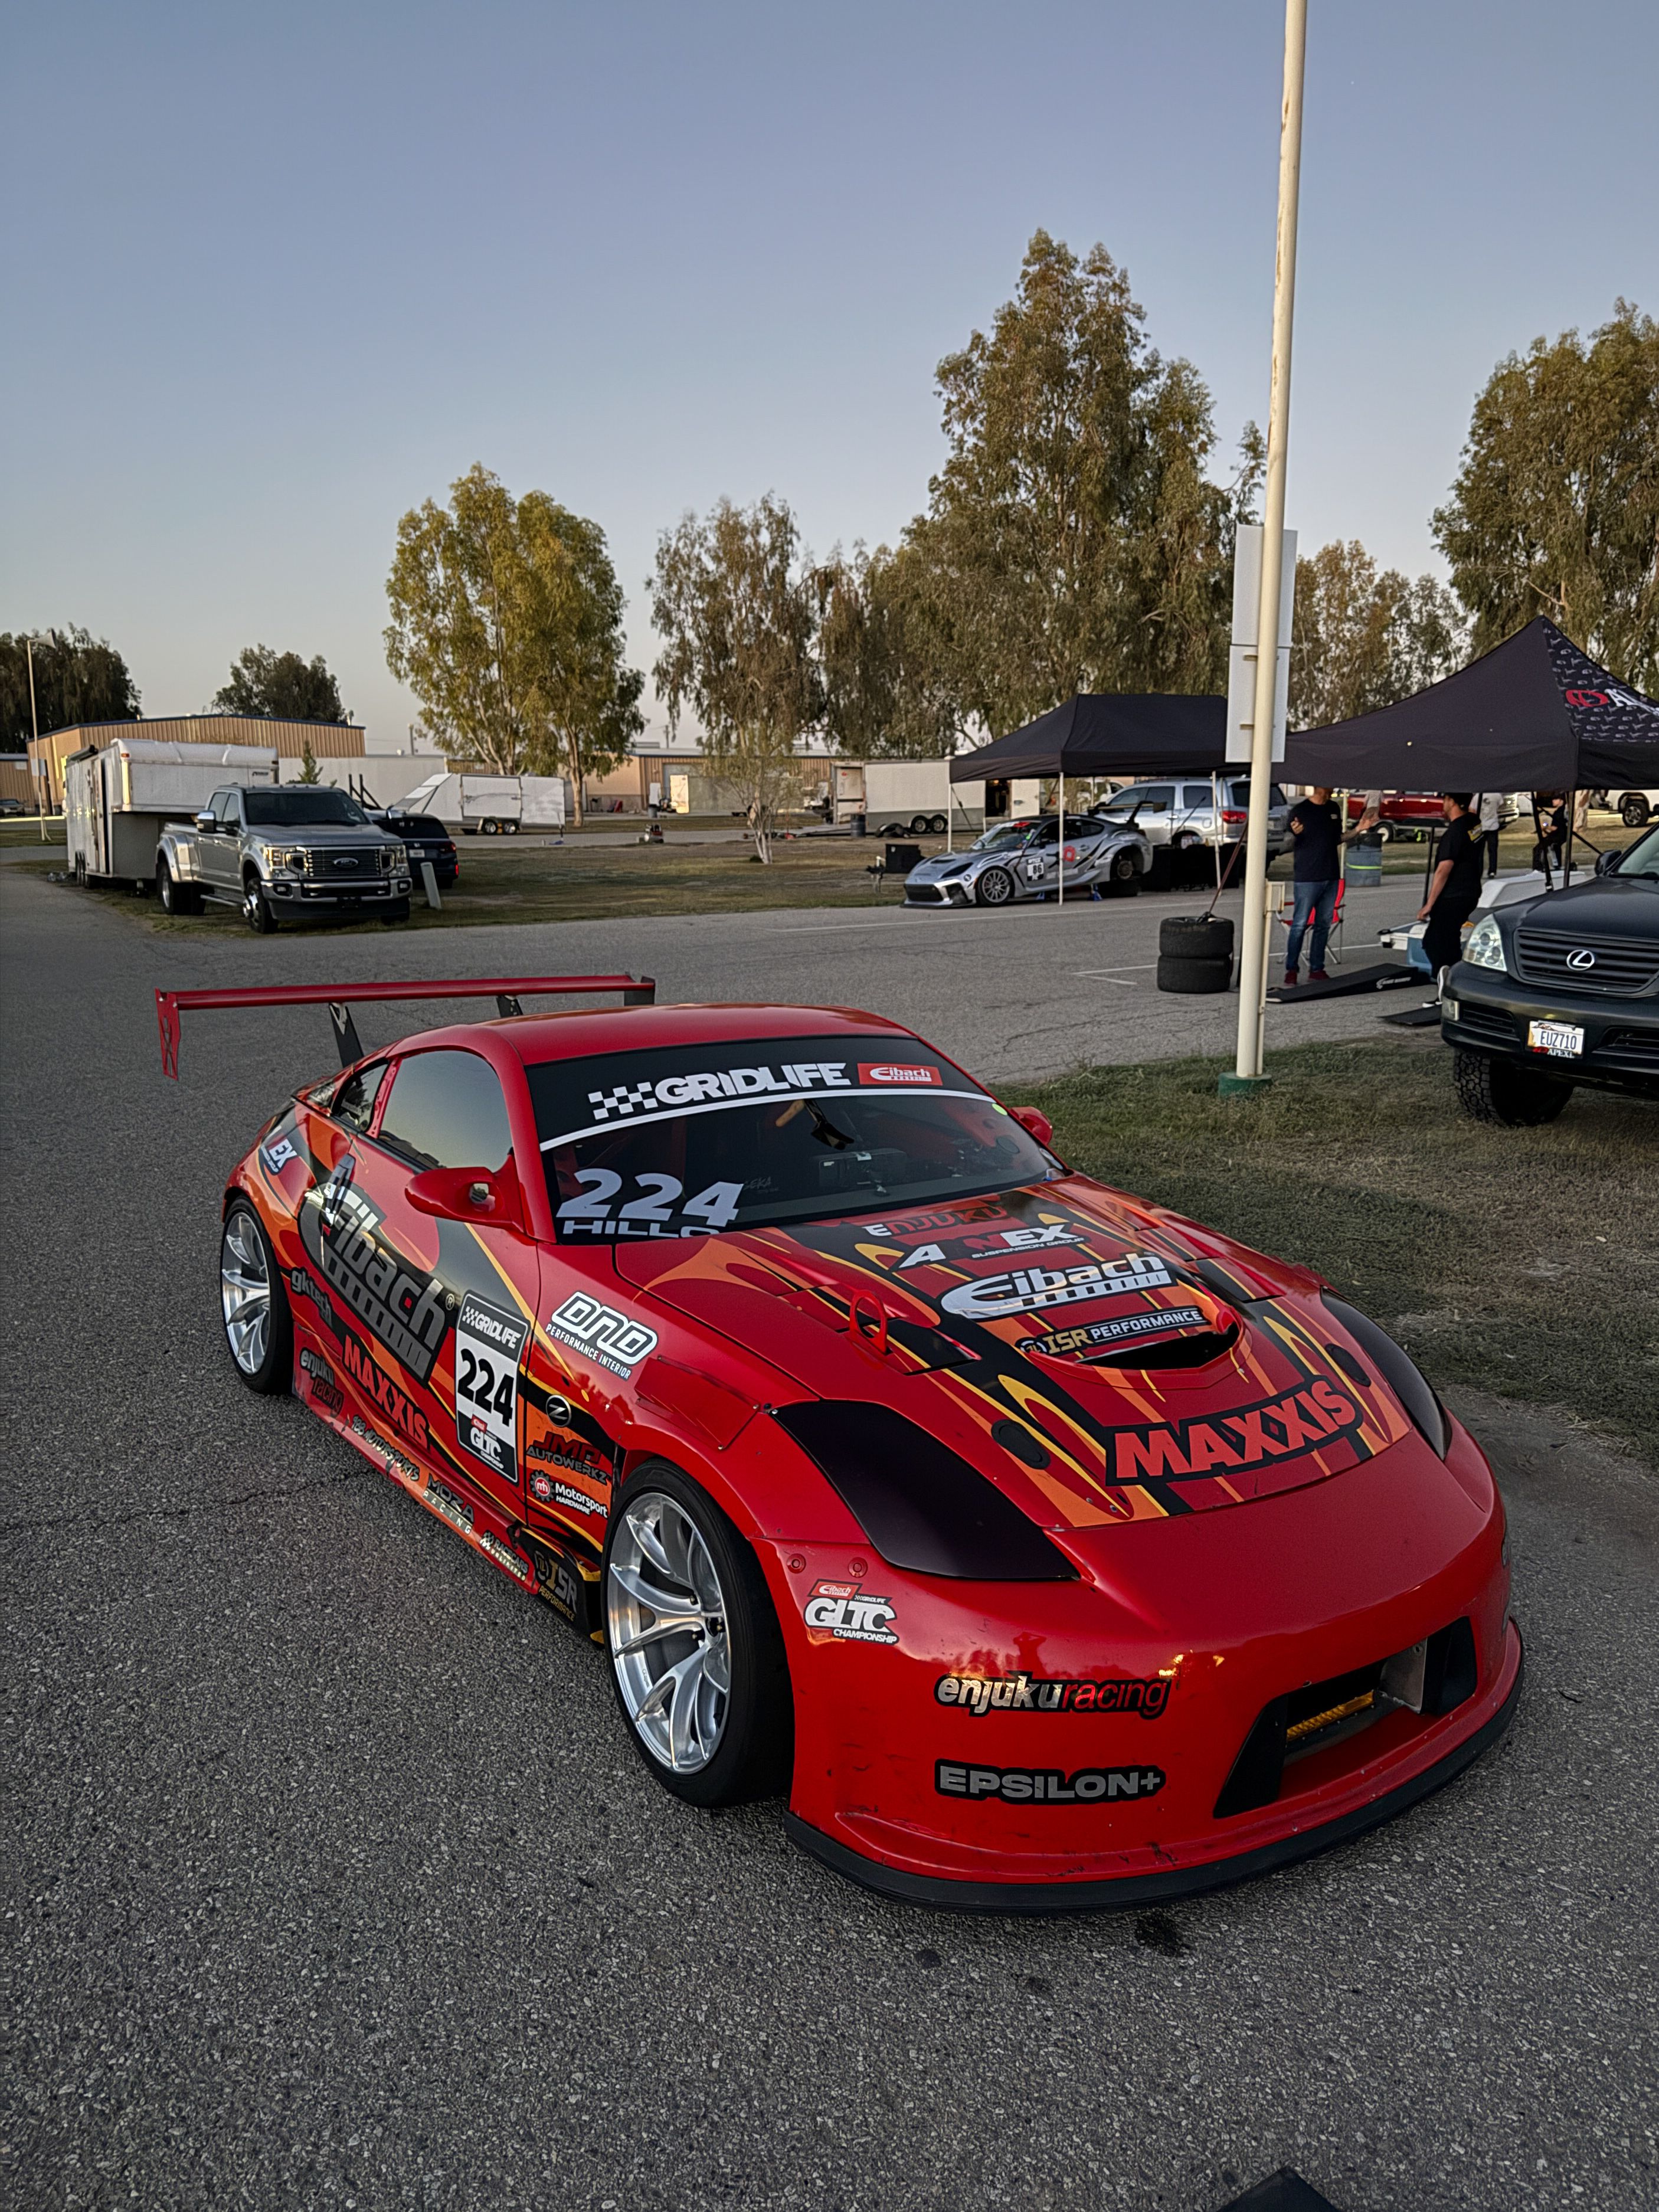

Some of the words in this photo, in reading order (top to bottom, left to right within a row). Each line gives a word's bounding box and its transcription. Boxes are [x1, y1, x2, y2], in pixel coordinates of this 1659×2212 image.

[1540, 1031, 1577, 1049] EUZ710
[656, 1062, 851, 1104] GRIDLIFE
[870, 1067, 932, 1082] Eibach
[556, 1168, 744, 1227] 224
[862, 1206, 1007, 1237] ENJUKU
[971, 1242, 1044, 1258] SUSPENSION
[1046, 1237, 1085, 1246] GROUP
[291, 1269, 332, 1326] gktech
[941, 1252, 1172, 1320] Eibach
[473, 1310, 521, 1349] GRIDLIFE
[1042, 1328, 1094, 1354] ISR
[1092, 1310, 1203, 1340] PERFORMANCE
[300, 1349, 333, 1386] enjuku
[545, 1323, 597, 1361] PERFORMANCE
[598, 1350, 631, 1380] INTERIOR
[313, 1376, 343, 1412] racing
[345, 1334, 427, 1447] MAXXIS
[458, 1349, 513, 1427] 224
[470, 1426, 502, 1461] GLTC
[1116, 1380, 1356, 1478] MAXXIS
[364, 1429, 420, 1481] MOTORSPORTS
[527, 1445, 608, 1485] AUTOWERKZ
[423, 1491, 473, 1534] RACING
[426, 1475, 474, 1523] MOZA
[555, 1482, 608, 1519] Motorsport
[555, 1495, 590, 1516] HARDWARE
[490, 1548, 526, 1582] UNLIMITED
[494, 1537, 529, 1574] RACECARS
[538, 1585, 575, 1621] PERFORMANCE
[546, 1559, 577, 1613] ISR
[819, 1585, 851, 1597] Eibach
[805, 1598, 895, 1633] GLTC
[833, 1628, 897, 1644] CHAMPIONSHIP
[940, 1765, 1161, 1798] EPSILON+
